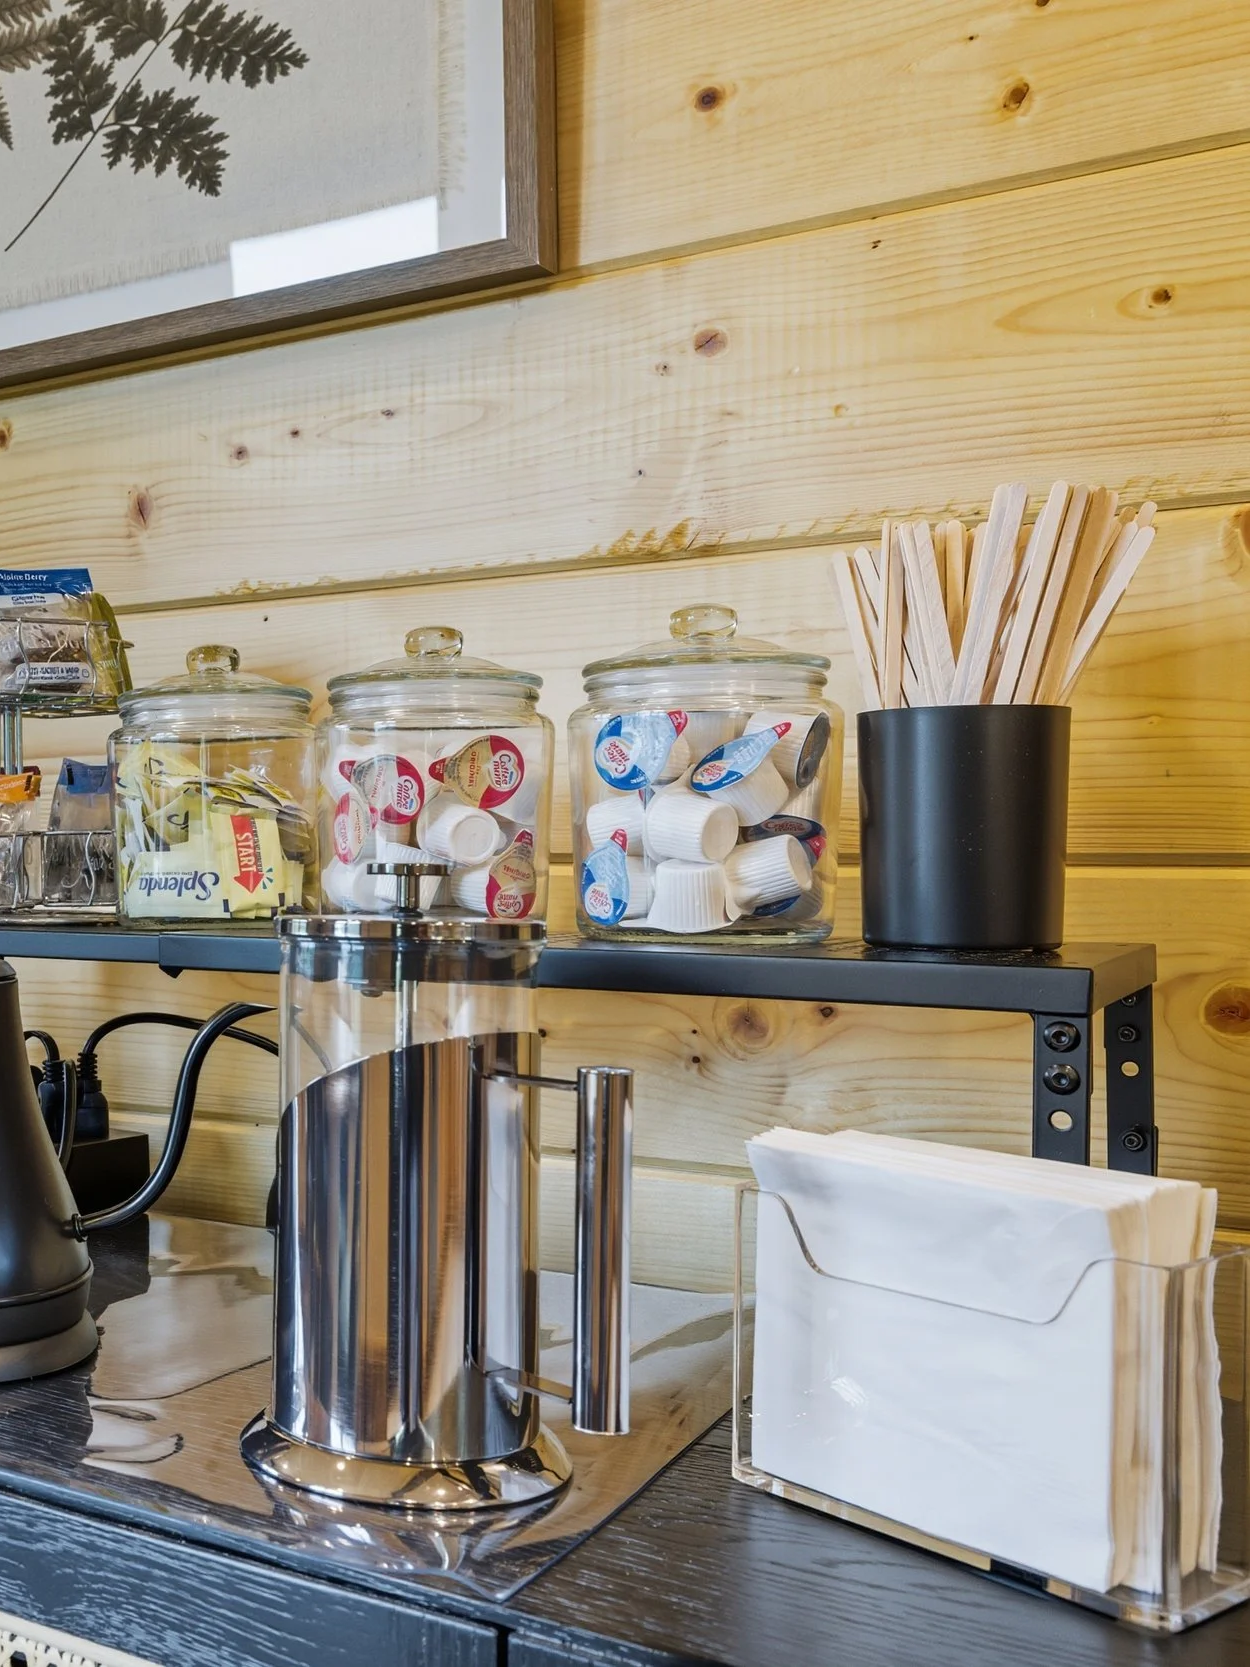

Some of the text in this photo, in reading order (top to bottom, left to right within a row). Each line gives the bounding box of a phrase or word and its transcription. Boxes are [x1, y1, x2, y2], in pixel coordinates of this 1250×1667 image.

[25, 573, 48, 582] Berry
[499, 753, 512, 786] Coffee
[604, 746, 627, 775] Coffee
[235, 831, 256, 873] START
[138, 870, 220, 901] Splenda
